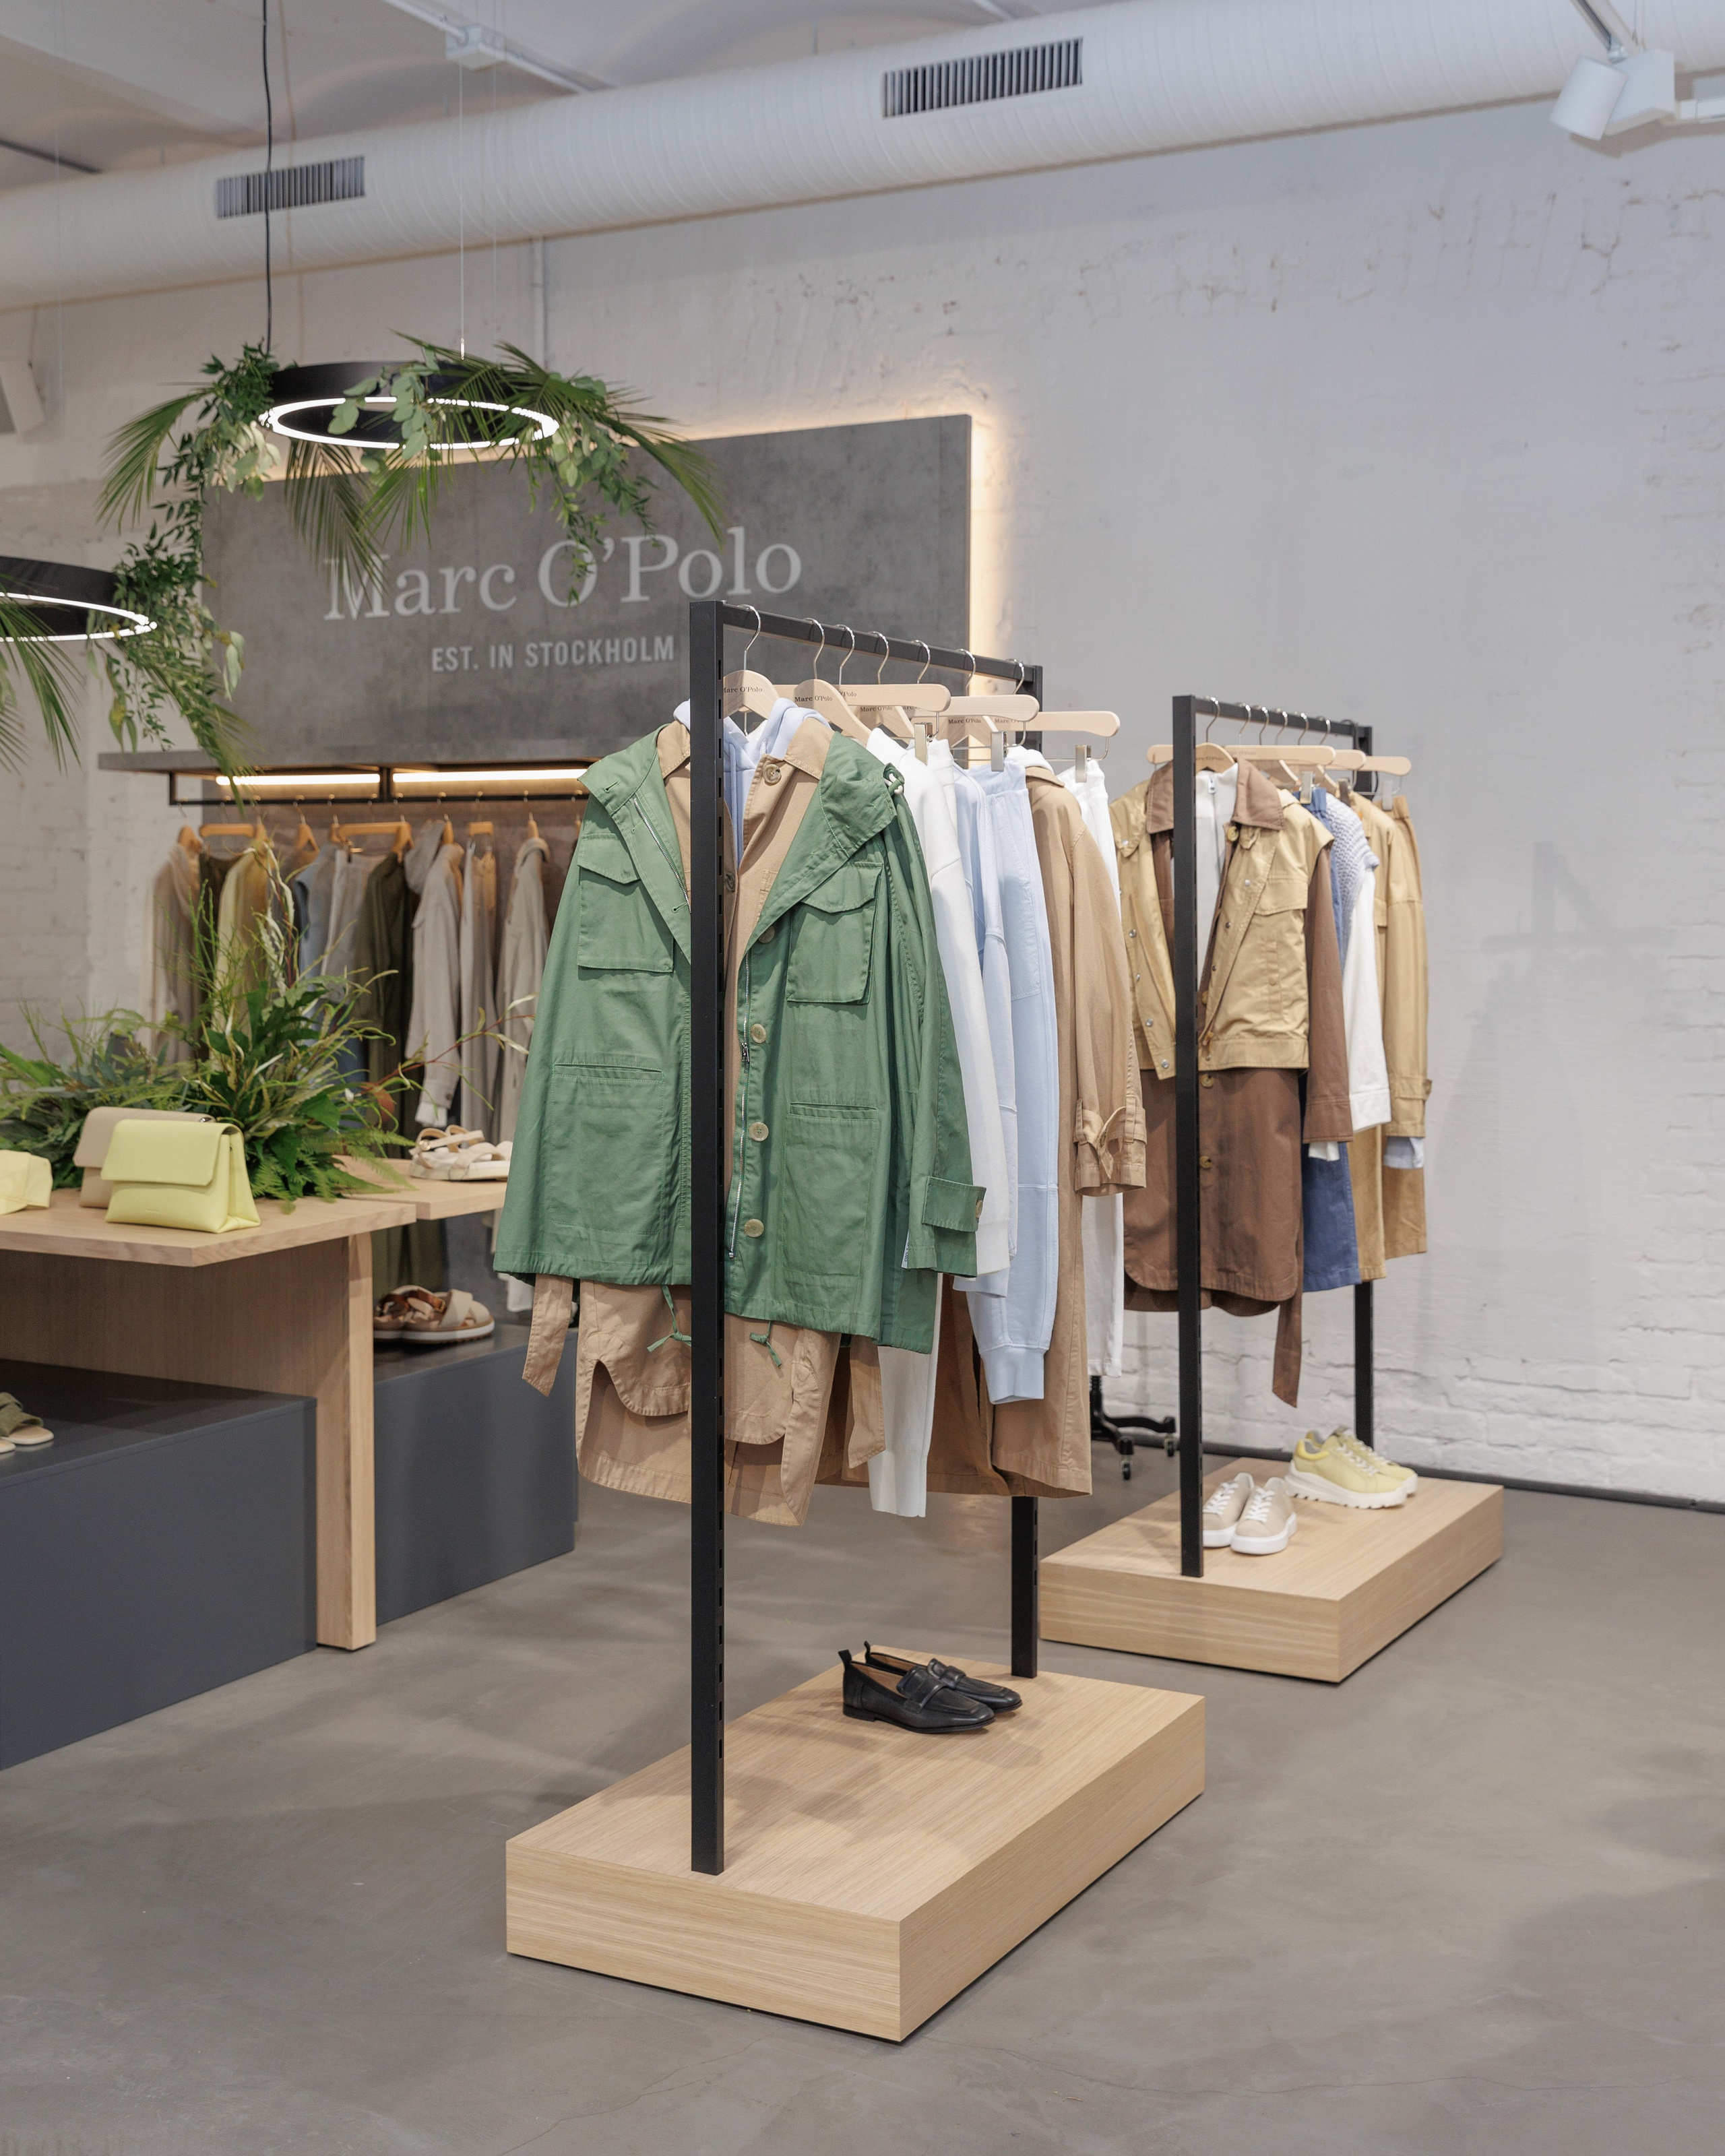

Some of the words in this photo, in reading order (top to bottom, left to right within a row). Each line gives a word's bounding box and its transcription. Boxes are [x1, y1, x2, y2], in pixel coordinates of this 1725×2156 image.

[323, 553, 517, 621] Marc
[538, 526, 802, 607] O'Polo
[431, 646, 480, 672] EST.
[489, 644, 514, 668] IN
[525, 635, 674, 668] STOCKHOLM
